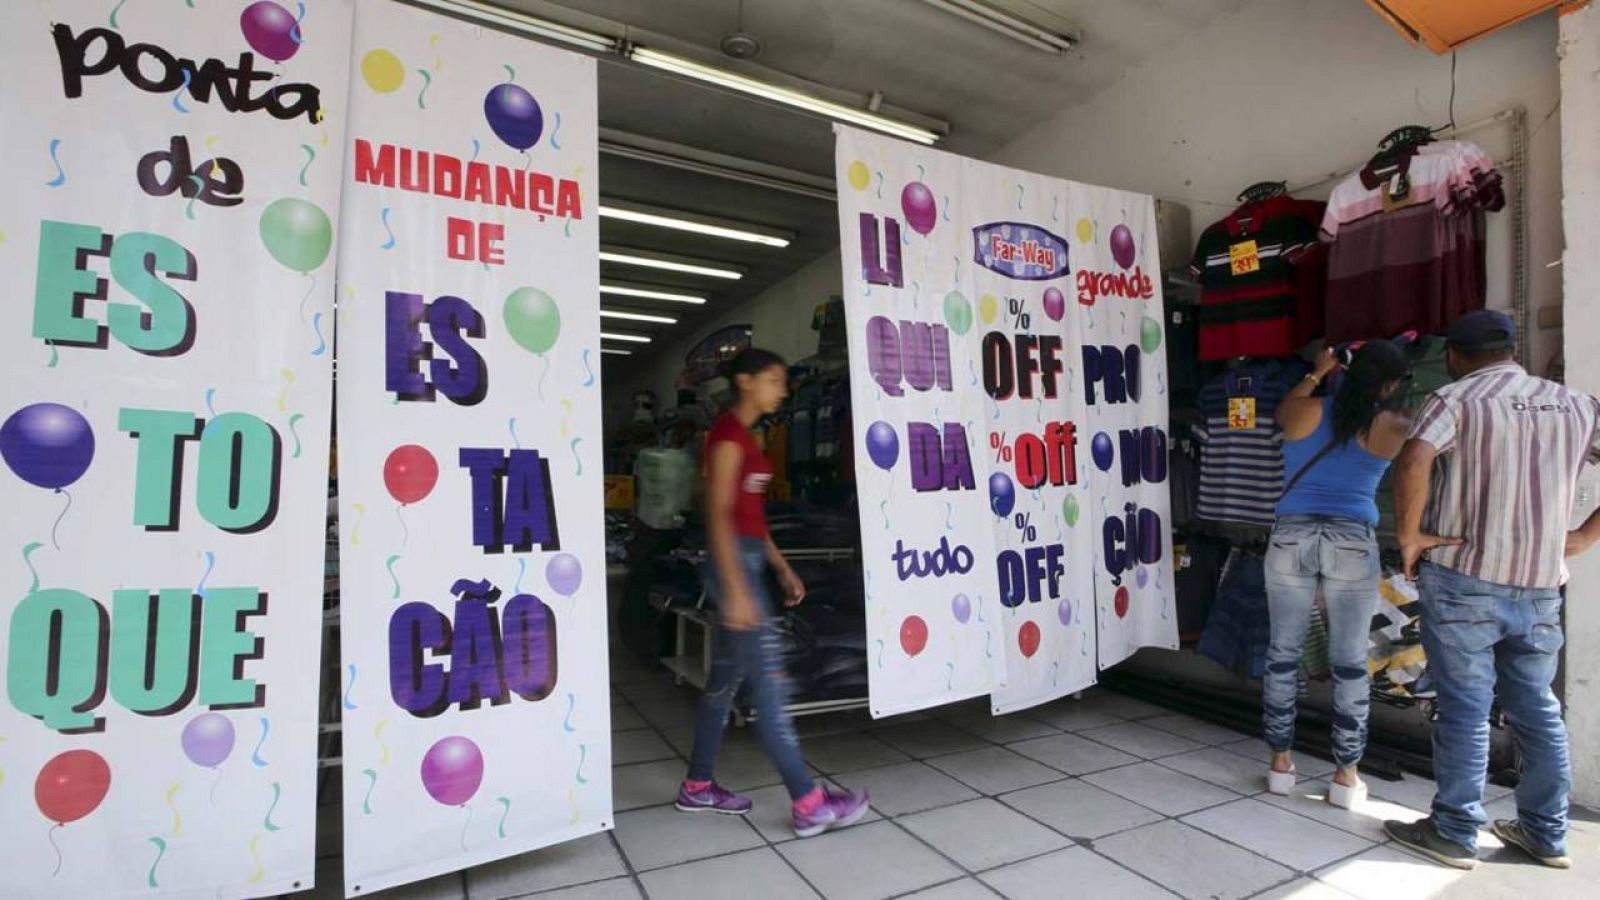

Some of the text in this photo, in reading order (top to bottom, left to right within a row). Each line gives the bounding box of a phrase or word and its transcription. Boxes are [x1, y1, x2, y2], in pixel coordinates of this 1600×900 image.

[50, 22, 323, 124] ponta
[137, 136, 244, 206] de
[354, 138, 582, 221] MUDANÇA
[447, 216, 505, 265] DE
[859, 212, 904, 288] LI
[32, 220, 198, 357] ES
[1075, 266, 1154, 306] grande
[384, 290, 488, 407] ES
[866, 315, 953, 397] QUI
[982, 331, 1064, 401] OFF
[1081, 344, 1141, 405] PRO
[118, 407, 282, 534] TO
[907, 421, 977, 491] DA
[459, 448, 561, 554] TA
[892, 536, 975, 581] tudo
[996, 543, 1065, 608] OFF
[6, 586, 269, 734] QUE
[388, 578, 558, 718] CÃO
